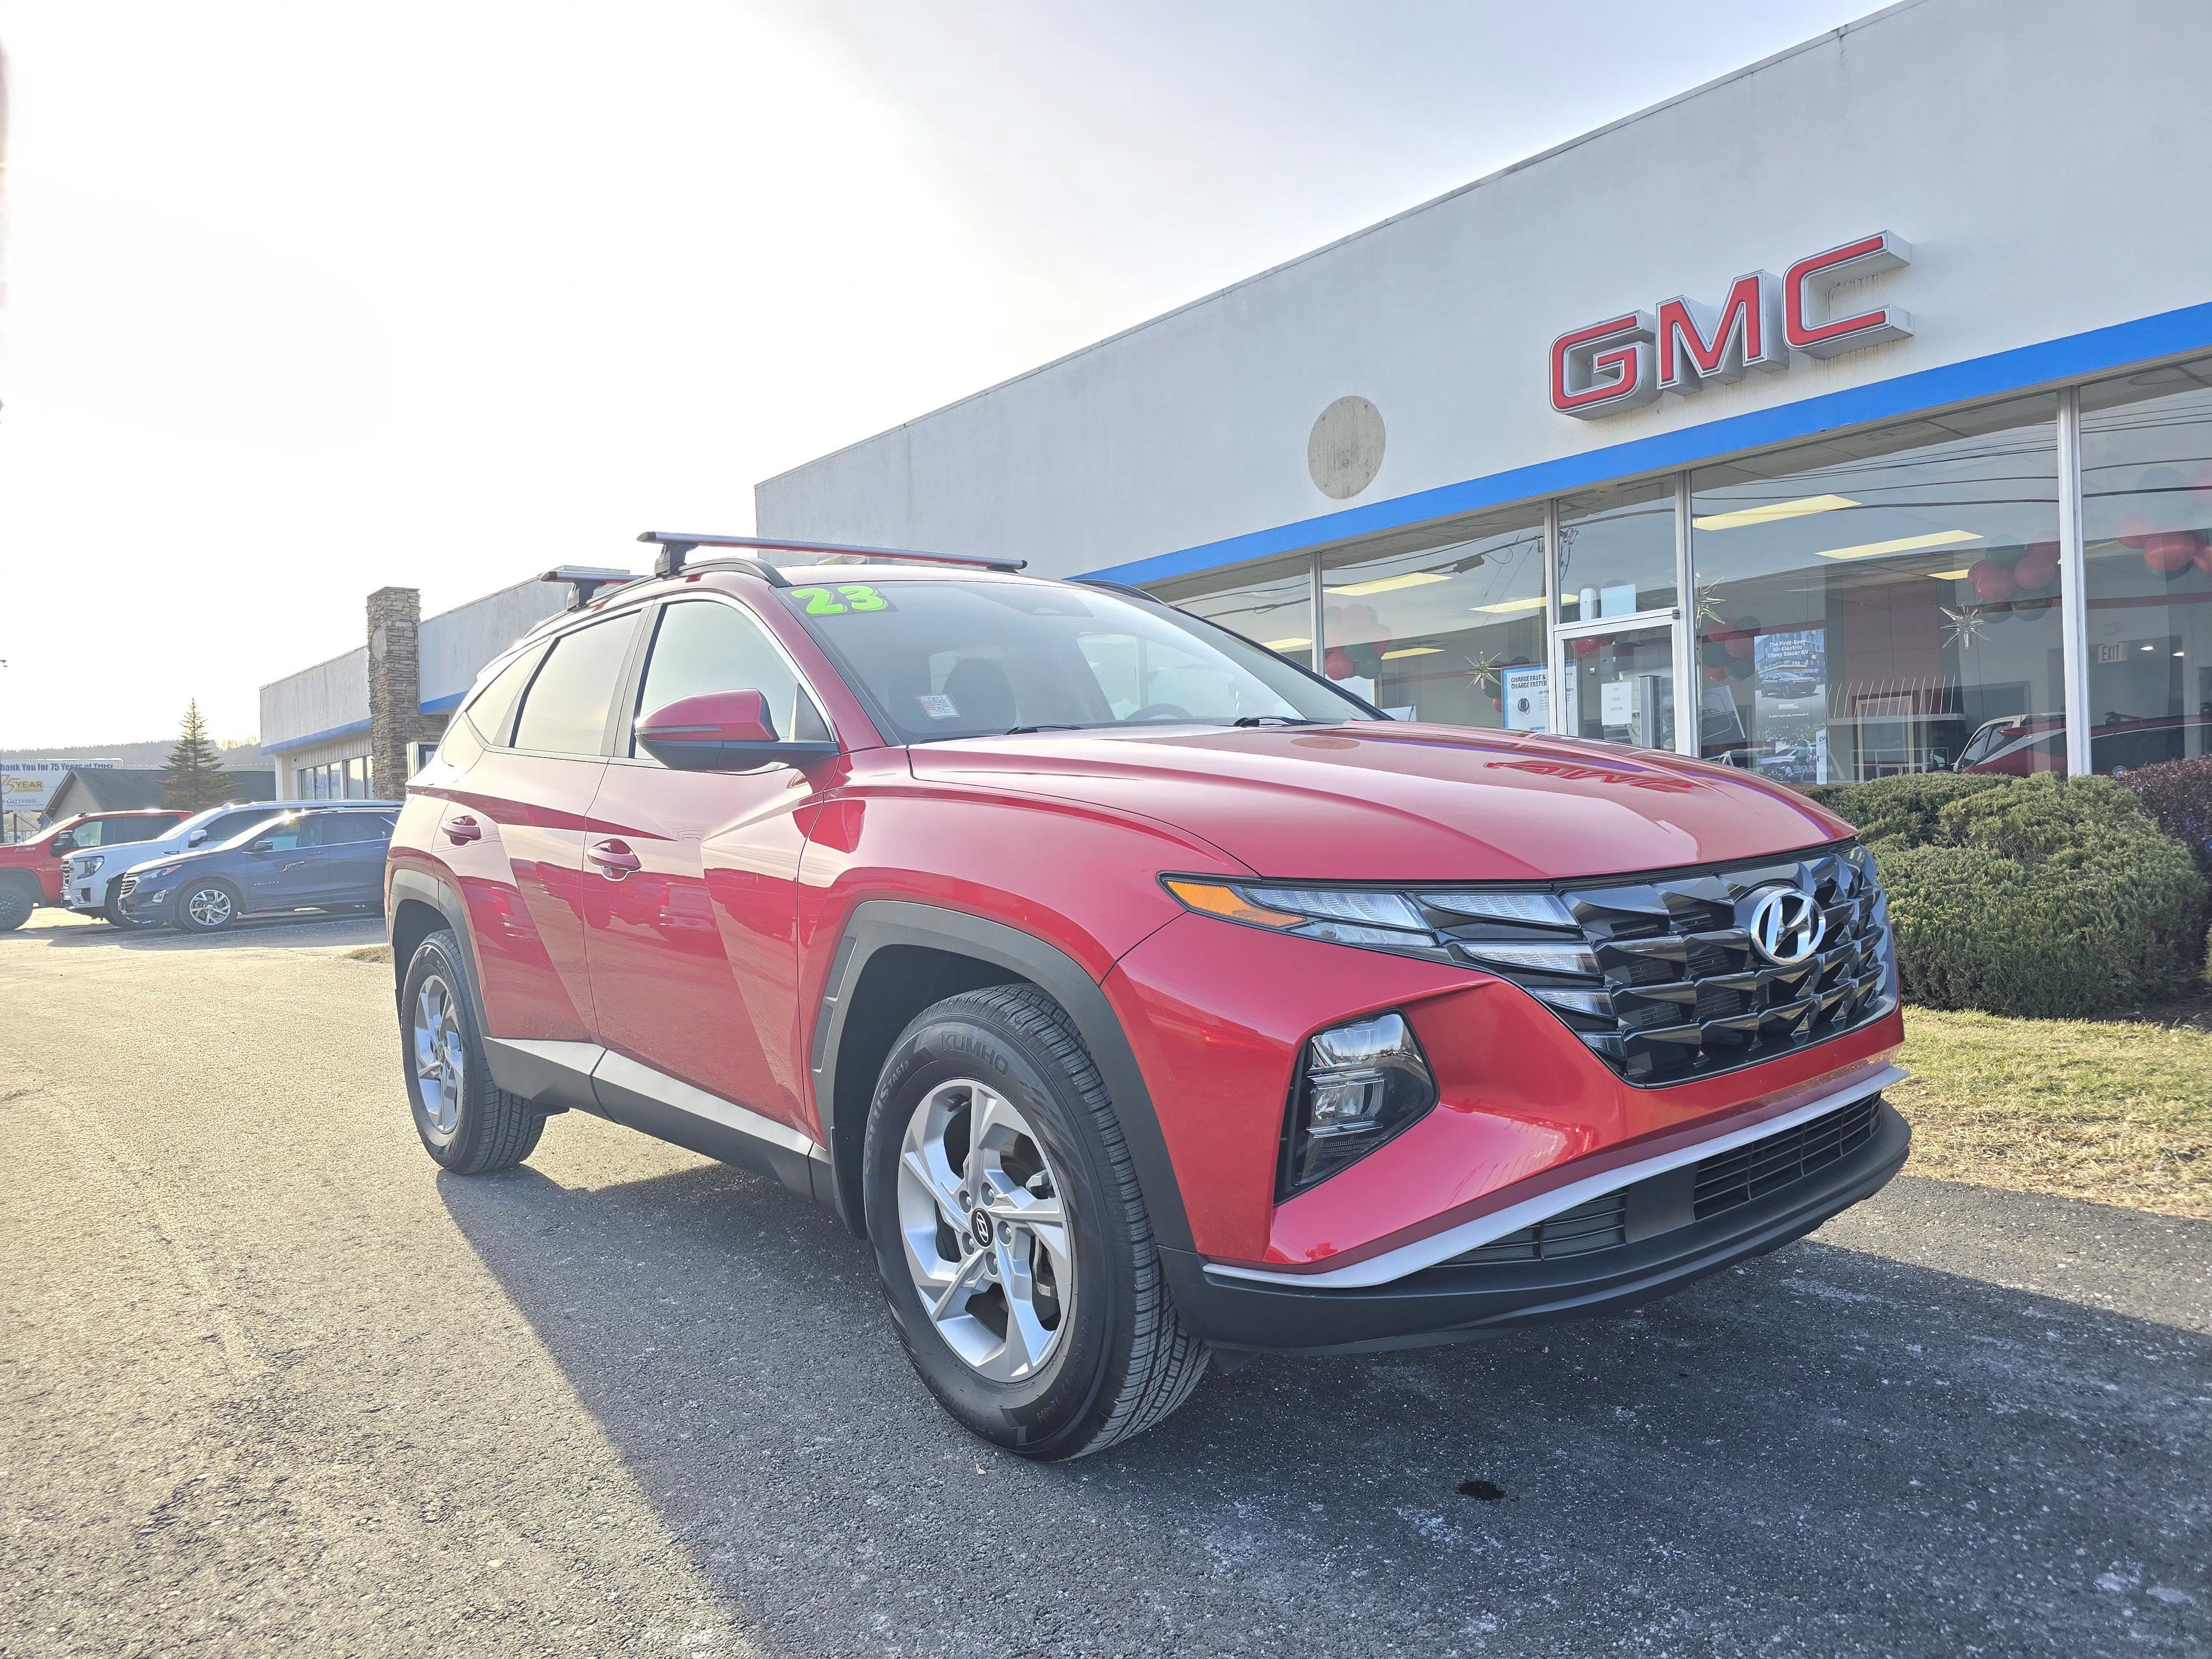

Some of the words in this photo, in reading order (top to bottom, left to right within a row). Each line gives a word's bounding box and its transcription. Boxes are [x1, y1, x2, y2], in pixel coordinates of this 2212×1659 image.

[1550, 230, 1911, 418] GMC
[791, 585, 888, 615] 23
[2102, 645, 2120, 661] EXIT
[0, 763, 20, 771] hank
[50, 763, 60, 771] 75
[941, 1033, 1009, 1076] KUMHO
[865, 1083, 890, 1176] SOLUS
[888, 1059, 910, 1089] TA51a
